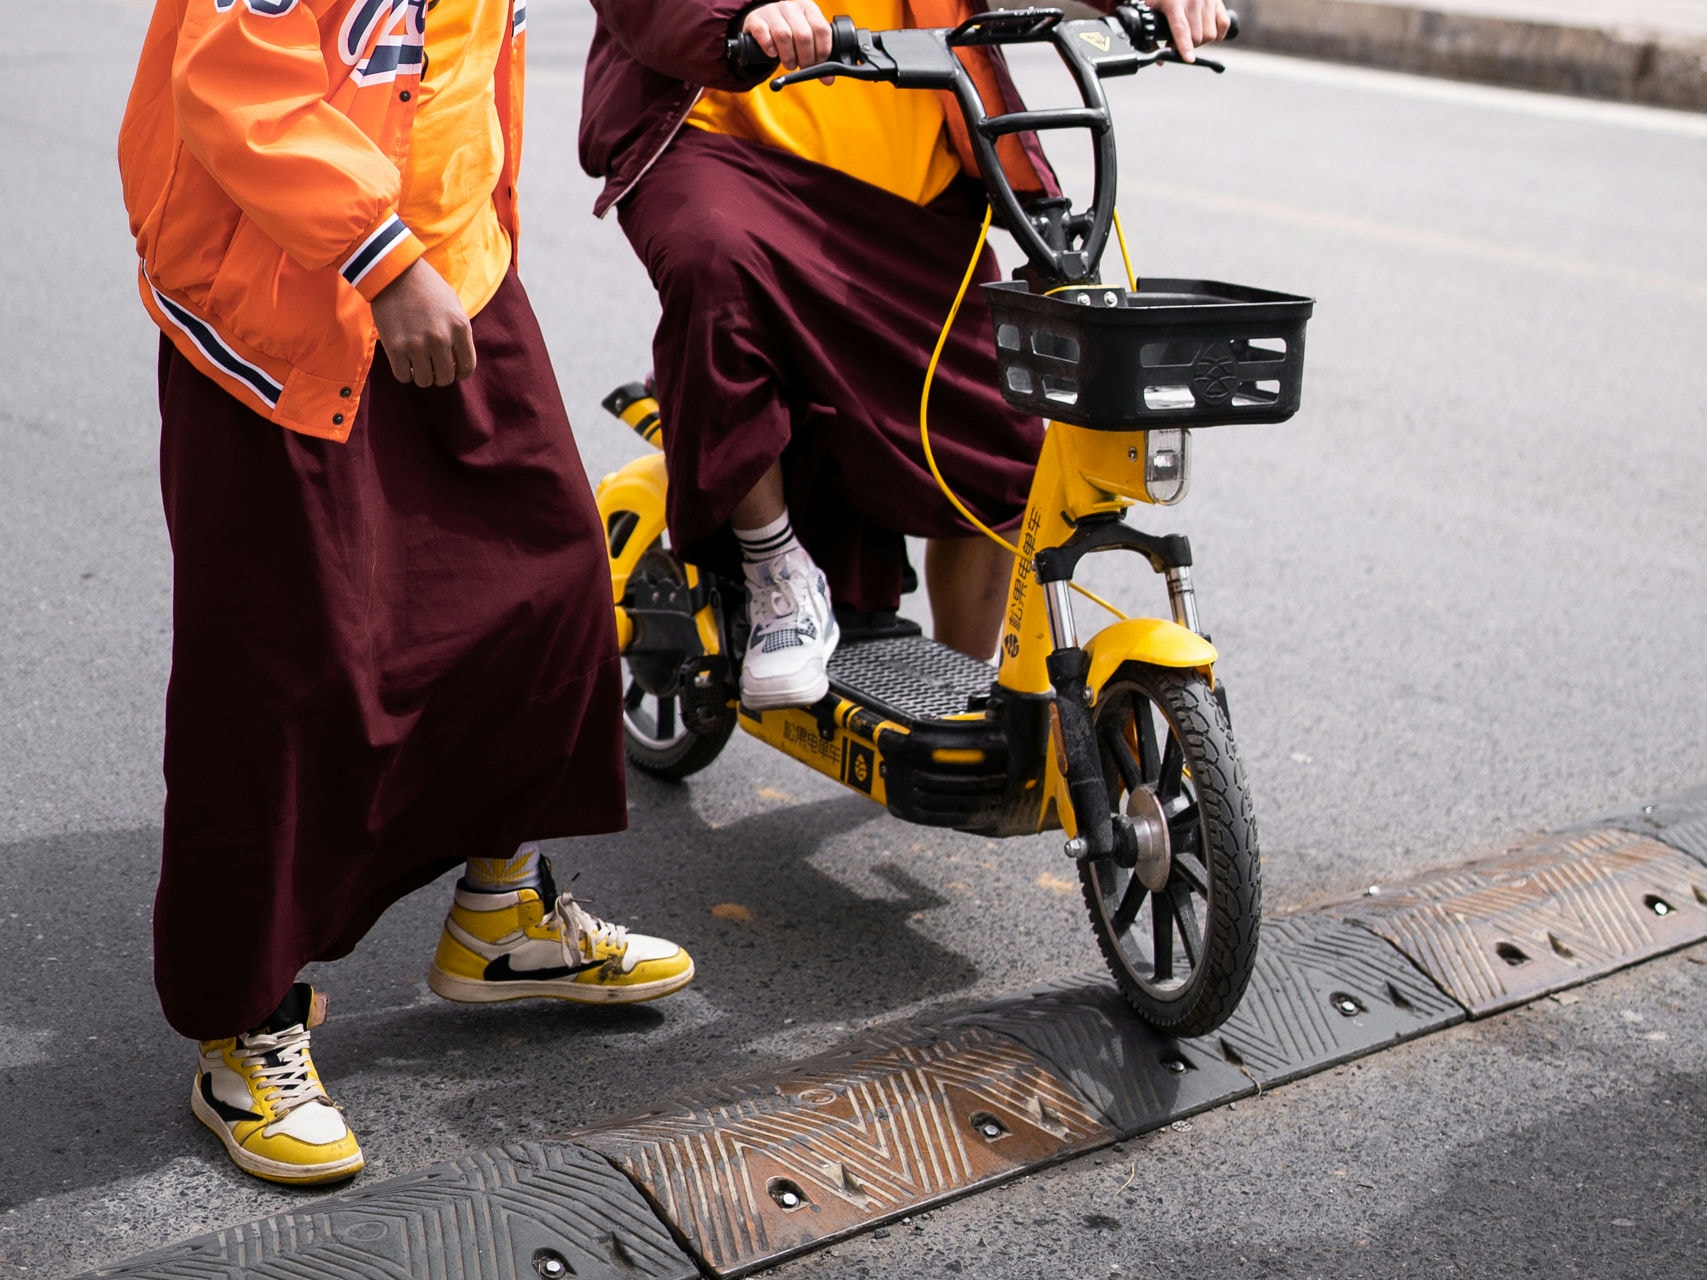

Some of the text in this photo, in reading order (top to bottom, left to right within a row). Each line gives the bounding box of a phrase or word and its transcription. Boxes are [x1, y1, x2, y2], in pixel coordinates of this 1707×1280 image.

[1009, 507, 1041, 631] 松果电单车
[784, 720, 841, 766] 松果电单车
